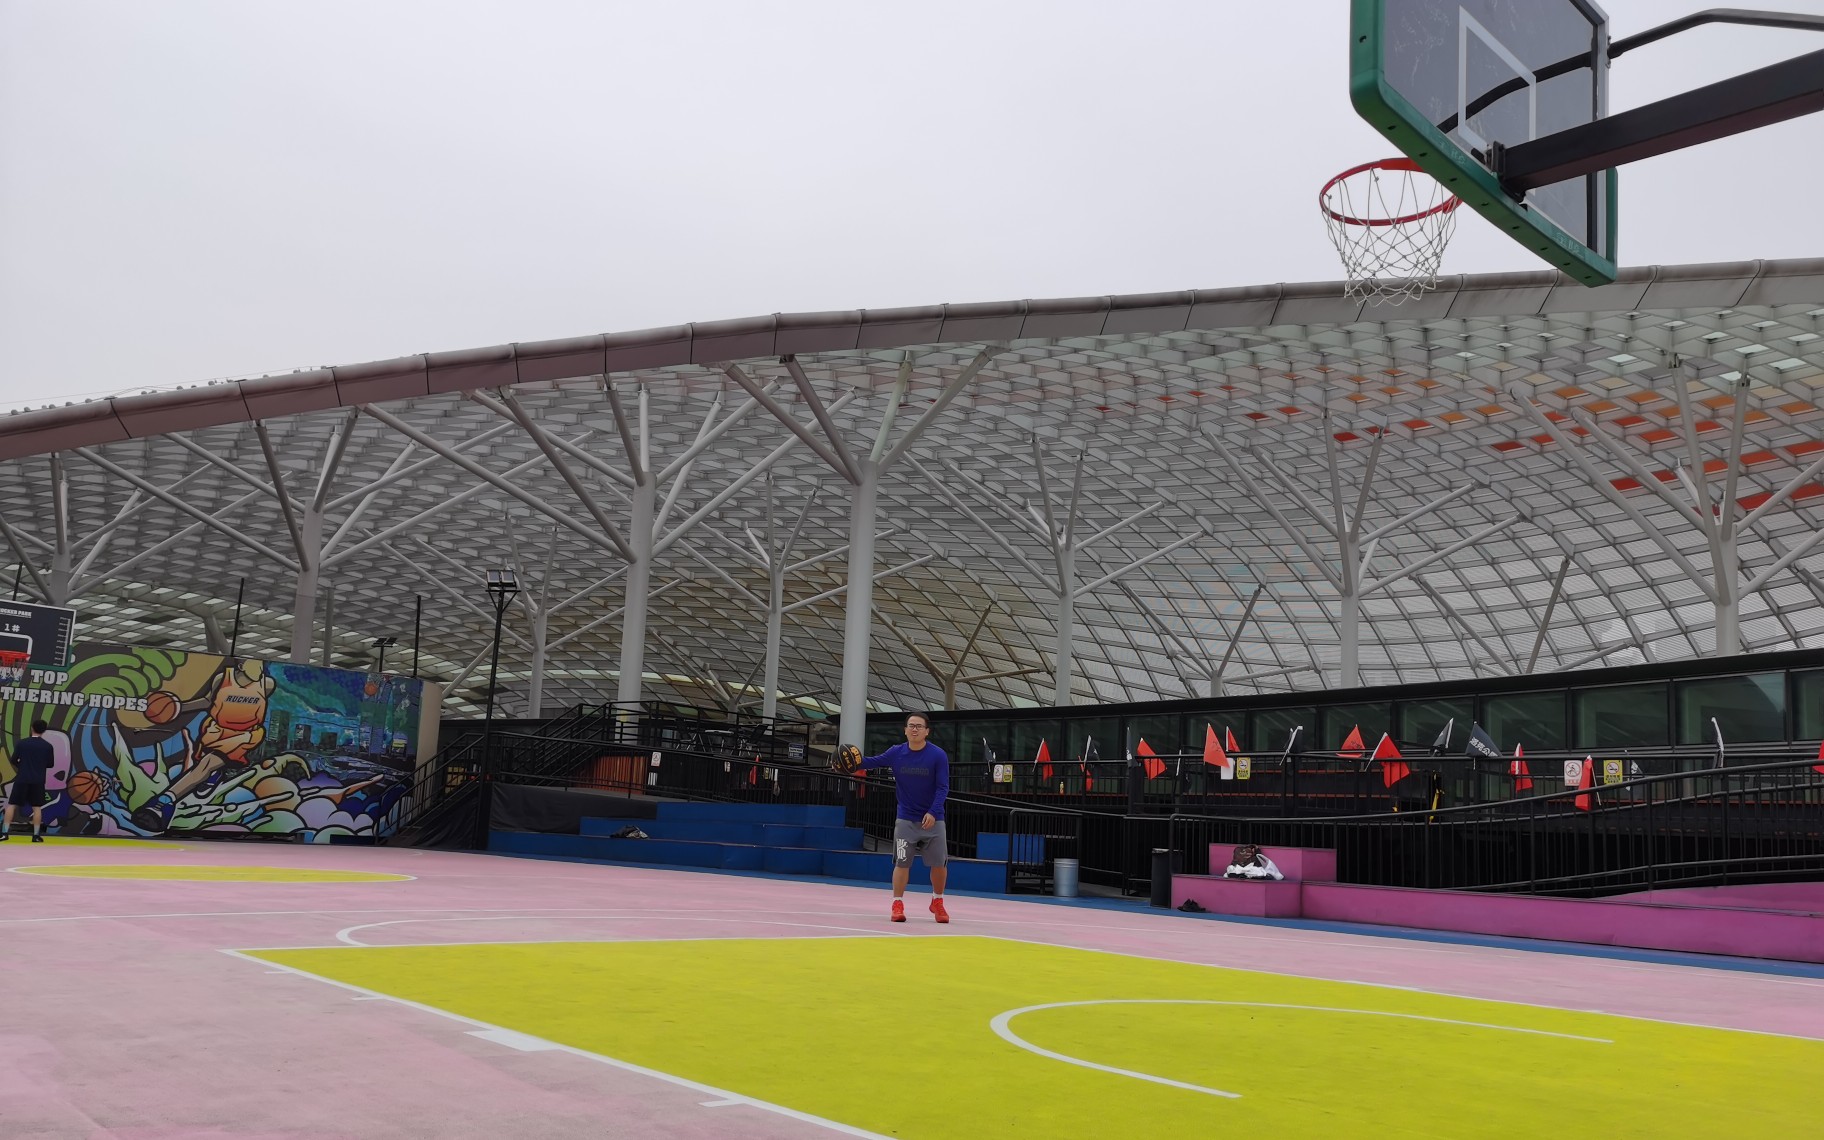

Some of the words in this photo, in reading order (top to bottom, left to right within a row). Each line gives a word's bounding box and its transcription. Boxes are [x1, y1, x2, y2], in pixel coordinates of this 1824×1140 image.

[30, 669, 68, 685] TOP
[0, 687, 84, 705] THERING
[88, 694, 148, 711] HOPES
[225, 695, 260, 704] RUCKER
